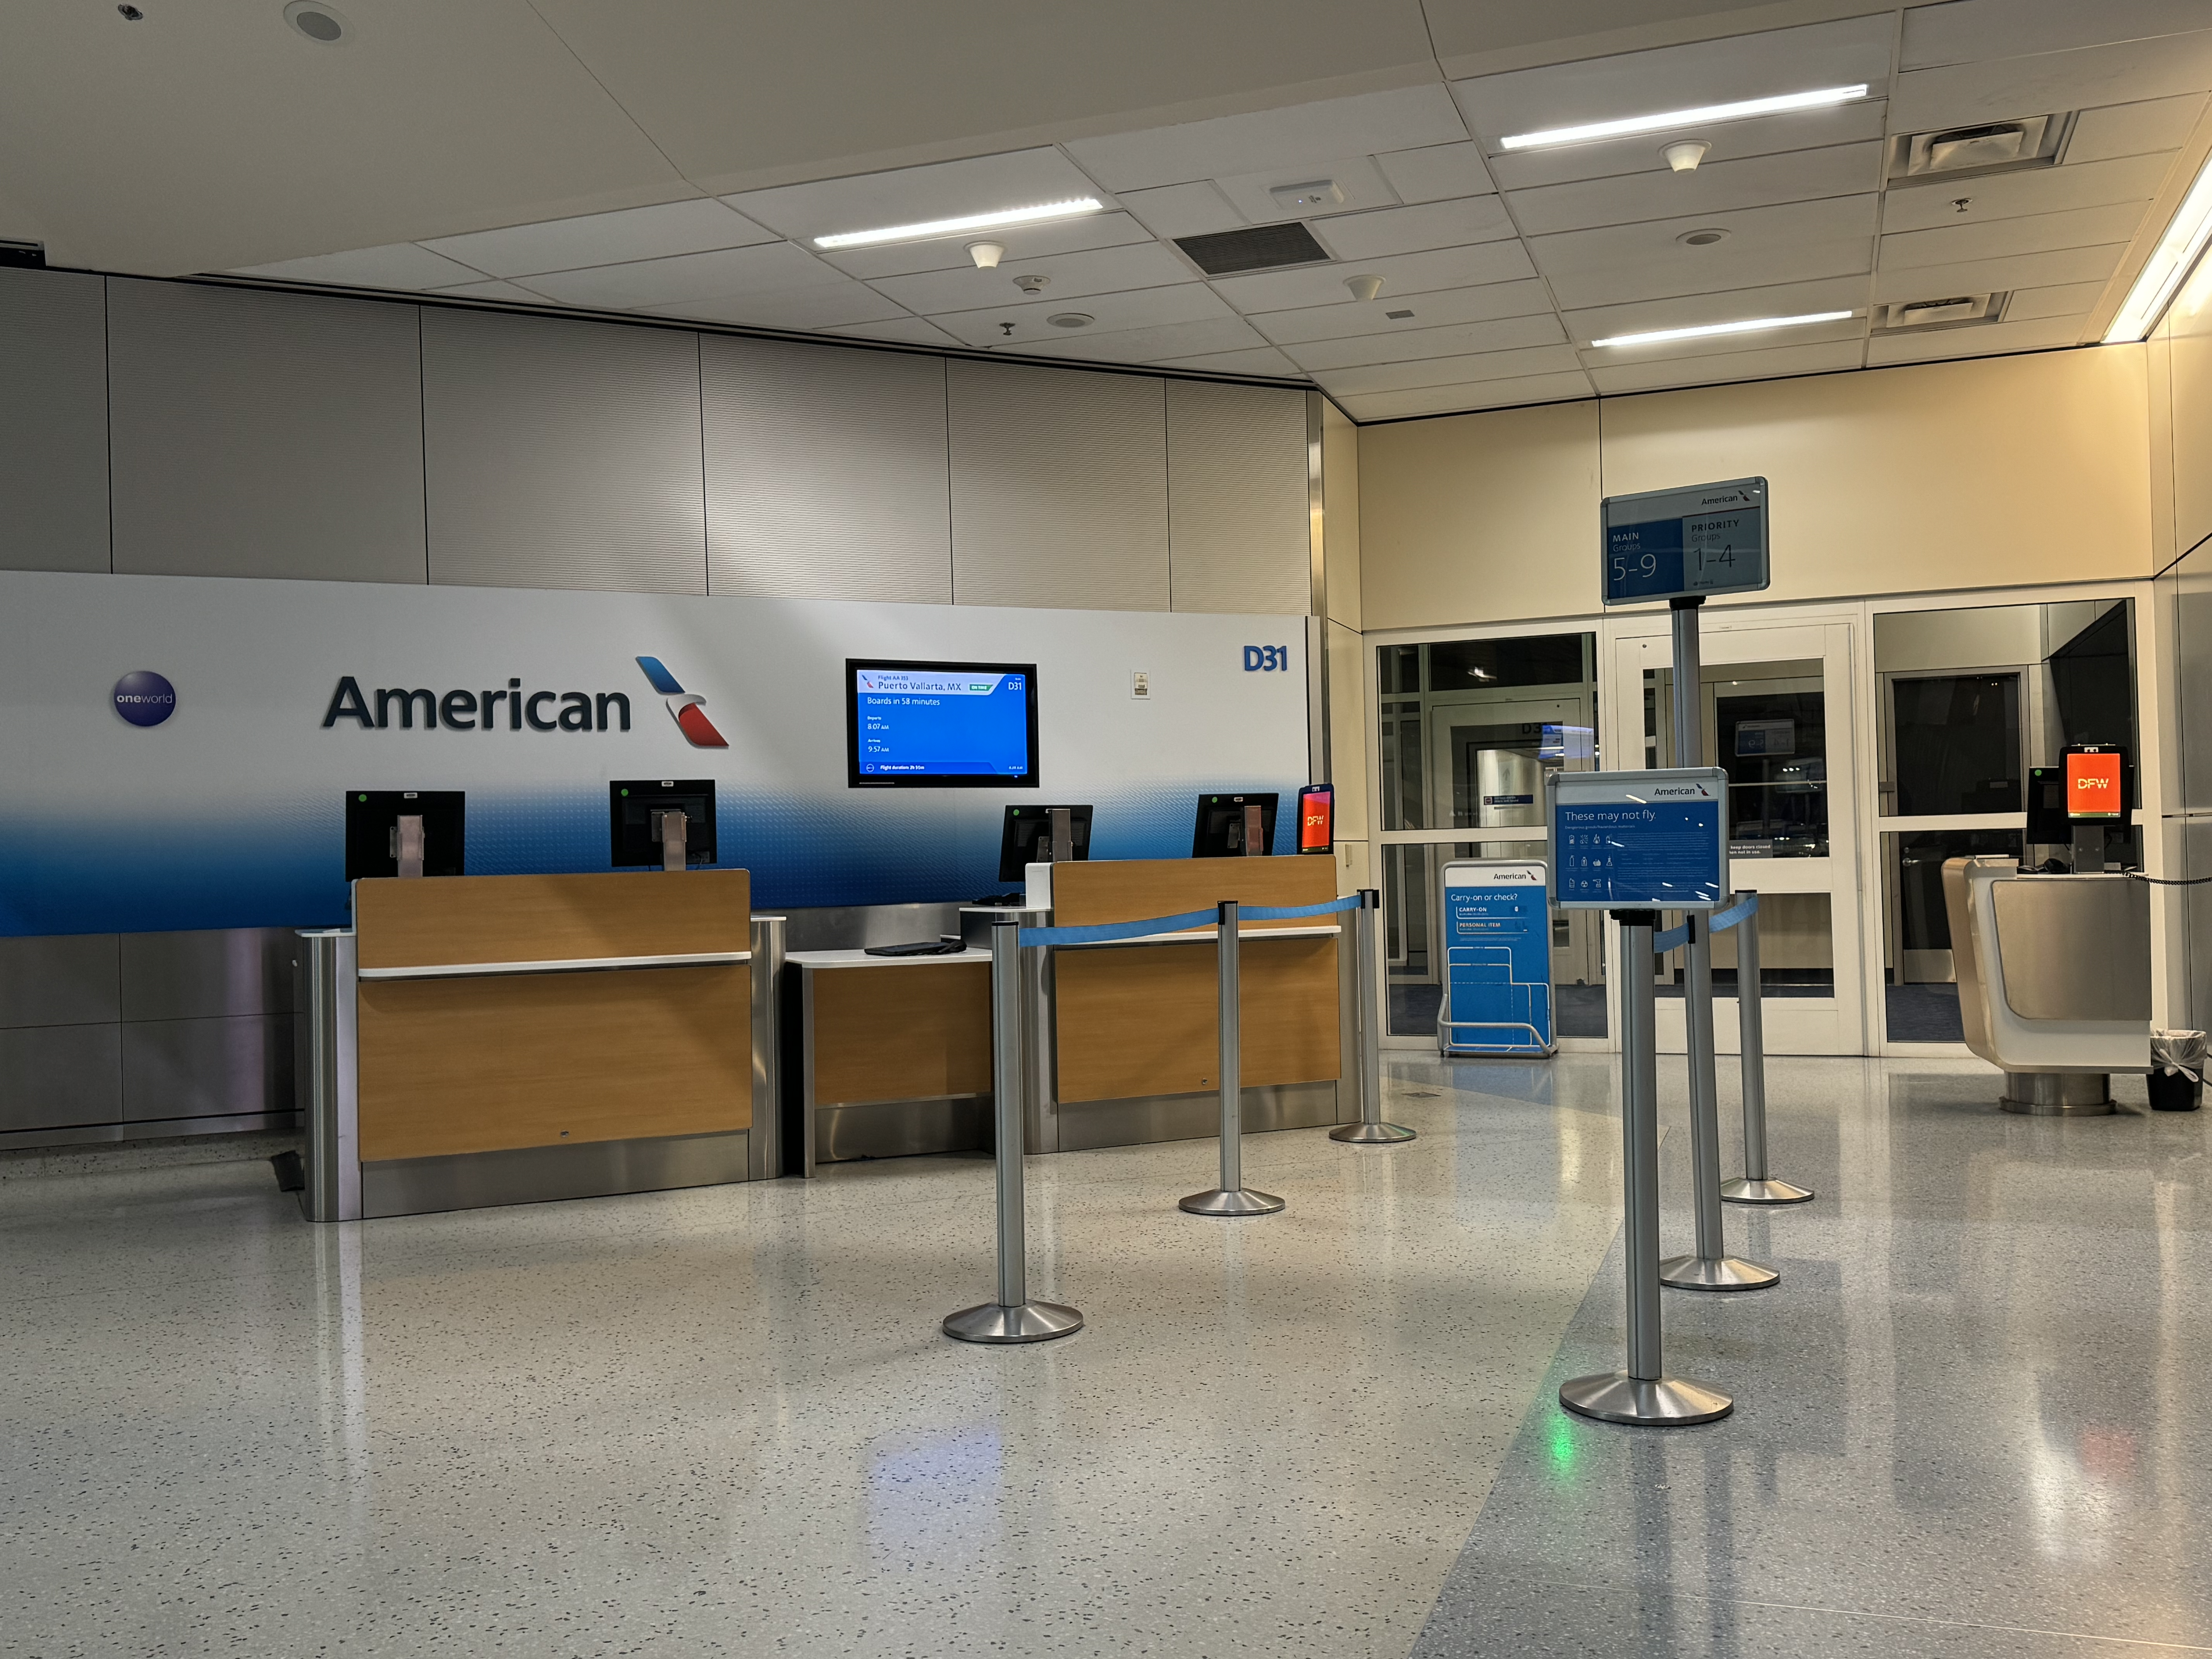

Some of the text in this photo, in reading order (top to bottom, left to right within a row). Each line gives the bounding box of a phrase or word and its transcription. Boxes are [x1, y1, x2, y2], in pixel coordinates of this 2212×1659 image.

[1702, 496, 1738, 505] American
[1692, 519, 1739, 532] PRIORITY
[1613, 532, 1639, 542] MAIN
[1692, 534, 1721, 542] Groups
[1613, 542, 1641, 552] Groups
[1693, 544, 1735, 571] 1-4
[1613, 554, 1656, 581] 5-9
[1244, 645, 1287, 671] D31
[910, 682, 945, 691] Vallarta,
[1008, 682, 1022, 690] D31
[117, 694, 173, 704] oneworld
[323, 676, 630, 731] American
[2078, 778, 2109, 789] DFW
[1654, 787, 1695, 796] American
[1307, 815, 1324, 826] DFW
[1565, 809, 1656, 823] These may not fly.
[1451, 894, 1482, 903] Carry-on
